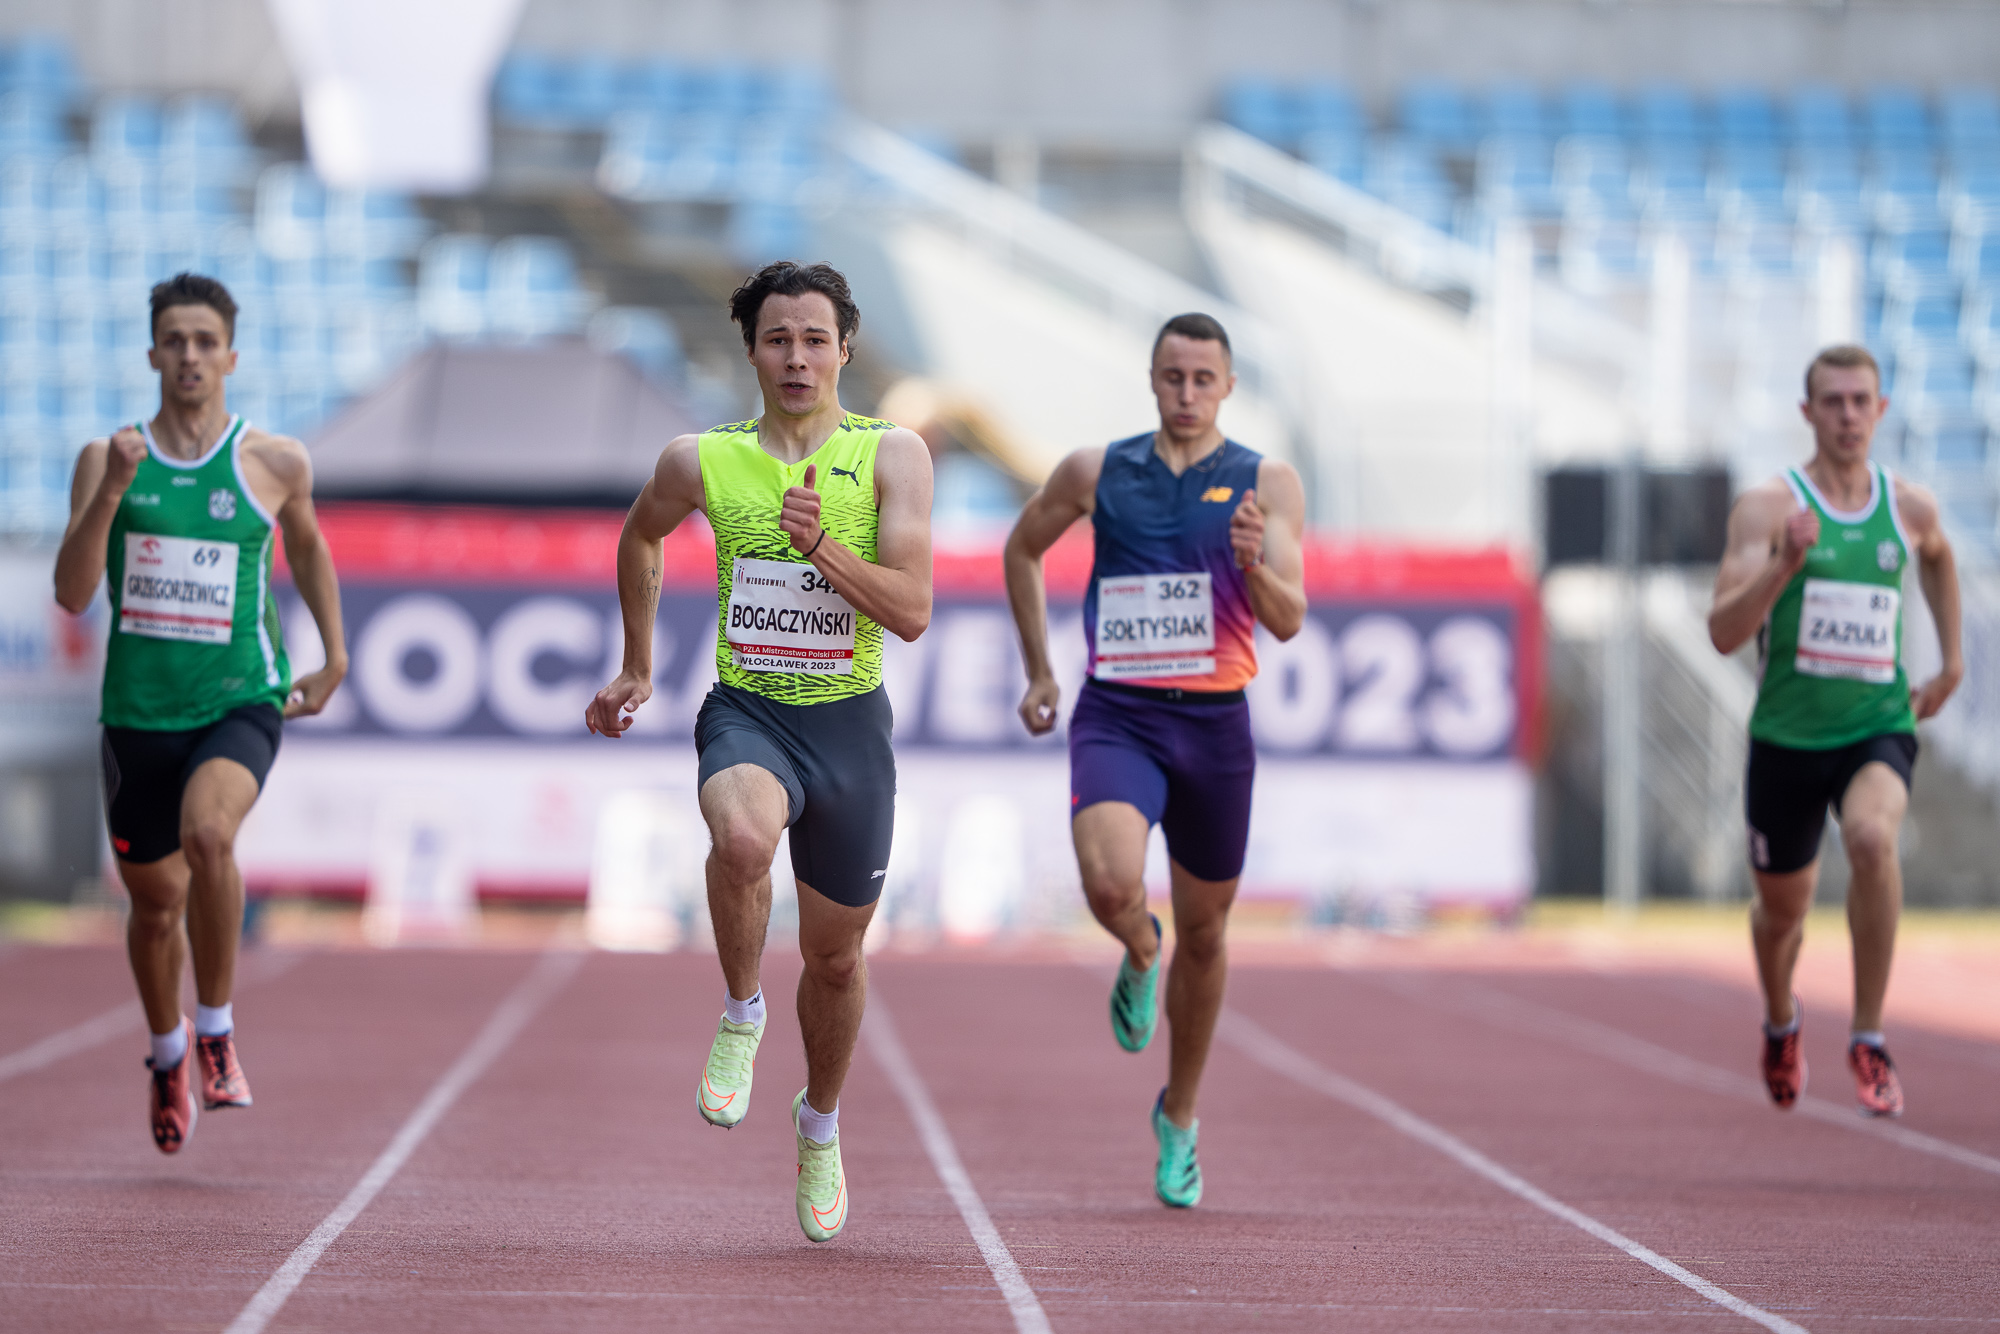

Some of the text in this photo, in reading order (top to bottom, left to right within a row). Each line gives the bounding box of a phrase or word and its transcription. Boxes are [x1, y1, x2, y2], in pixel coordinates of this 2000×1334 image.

[193, 547, 221, 568] 69
[746, 577, 786, 588] WZORCOWNIA
[801, 571, 840, 593] 34
[1159, 580, 1200, 600] 362
[732, 605, 851, 635] BOGACZYŃSKI
[1102, 614, 1207, 642] SOŁTYSIAK
[743, 645, 761, 654] PZLA
[762, 648, 807, 657] Mistrzostwa
[740, 656, 836, 670] WŁOCŁAWEK 2023
[1250, 612, 1515, 753] 023
